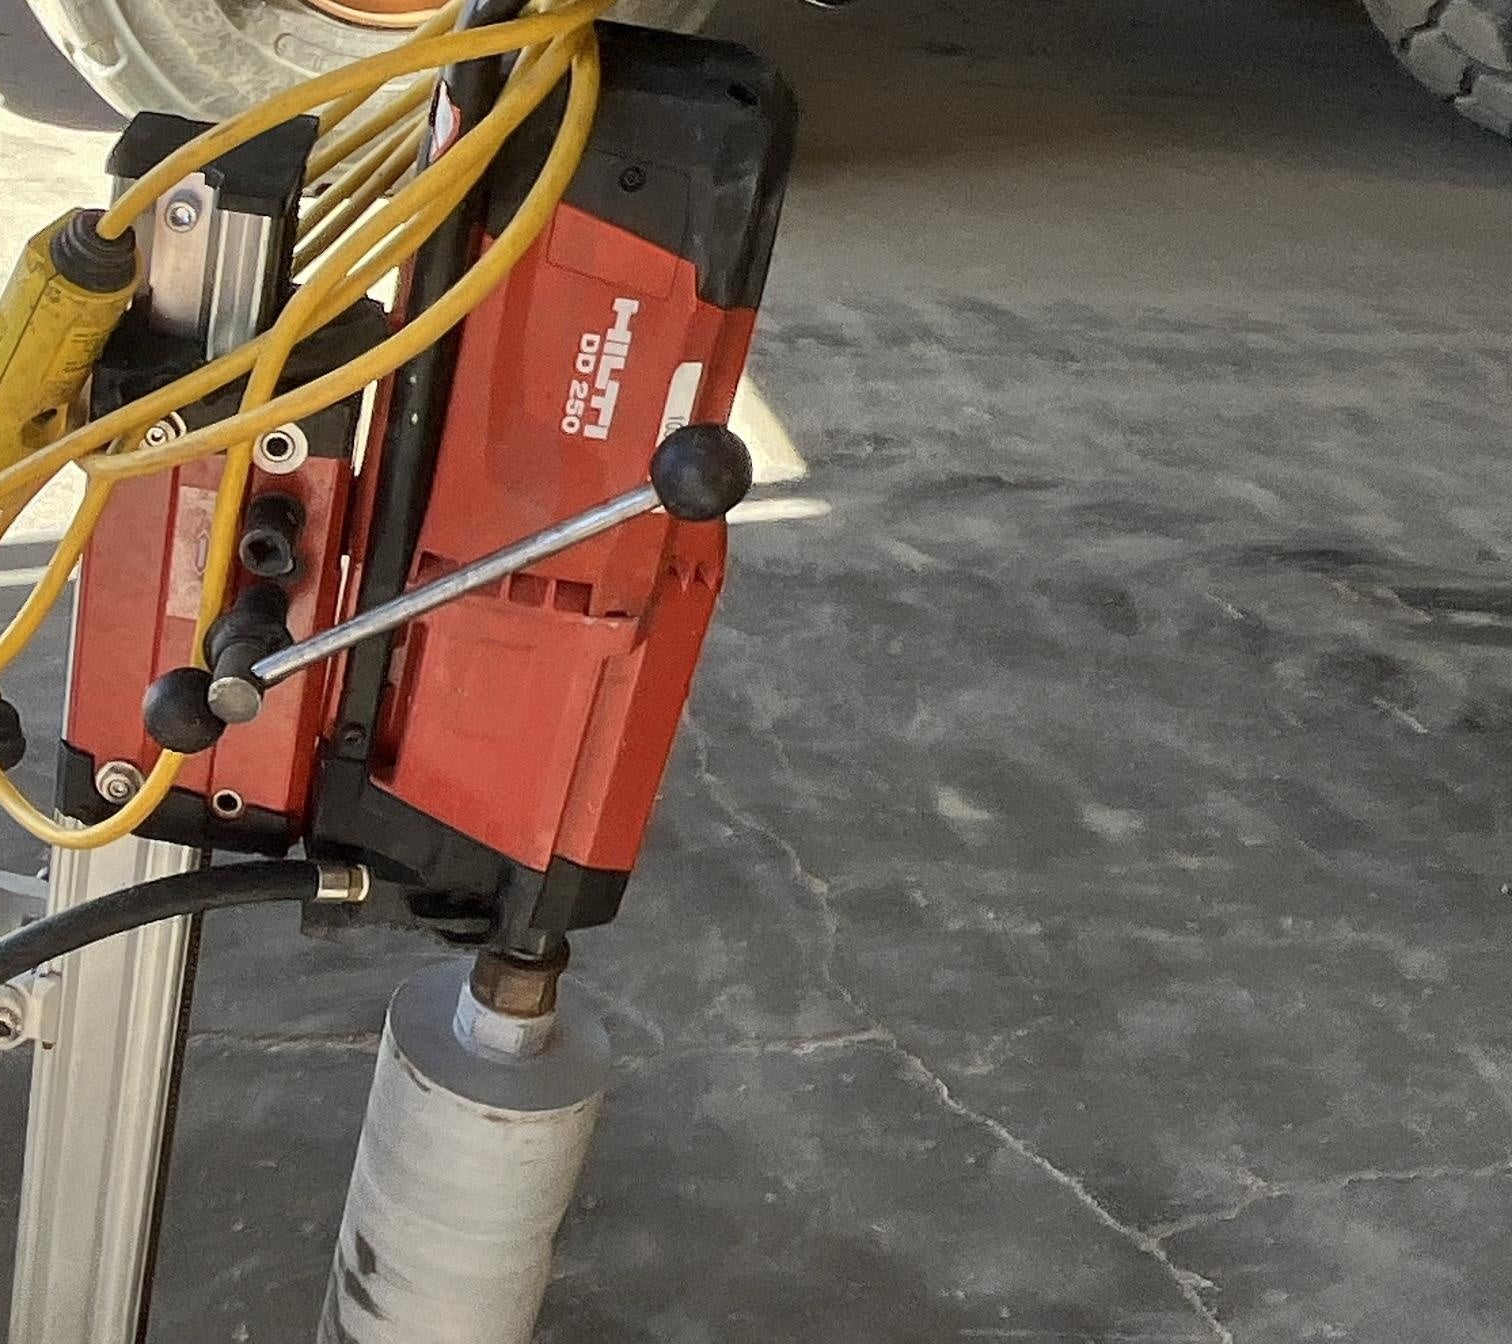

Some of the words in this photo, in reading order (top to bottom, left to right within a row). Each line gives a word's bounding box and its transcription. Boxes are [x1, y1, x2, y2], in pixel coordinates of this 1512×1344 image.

[575, 332, 601, 374] DD
[582, 297, 640, 440] HILTI
[560, 379, 589, 434] 250
